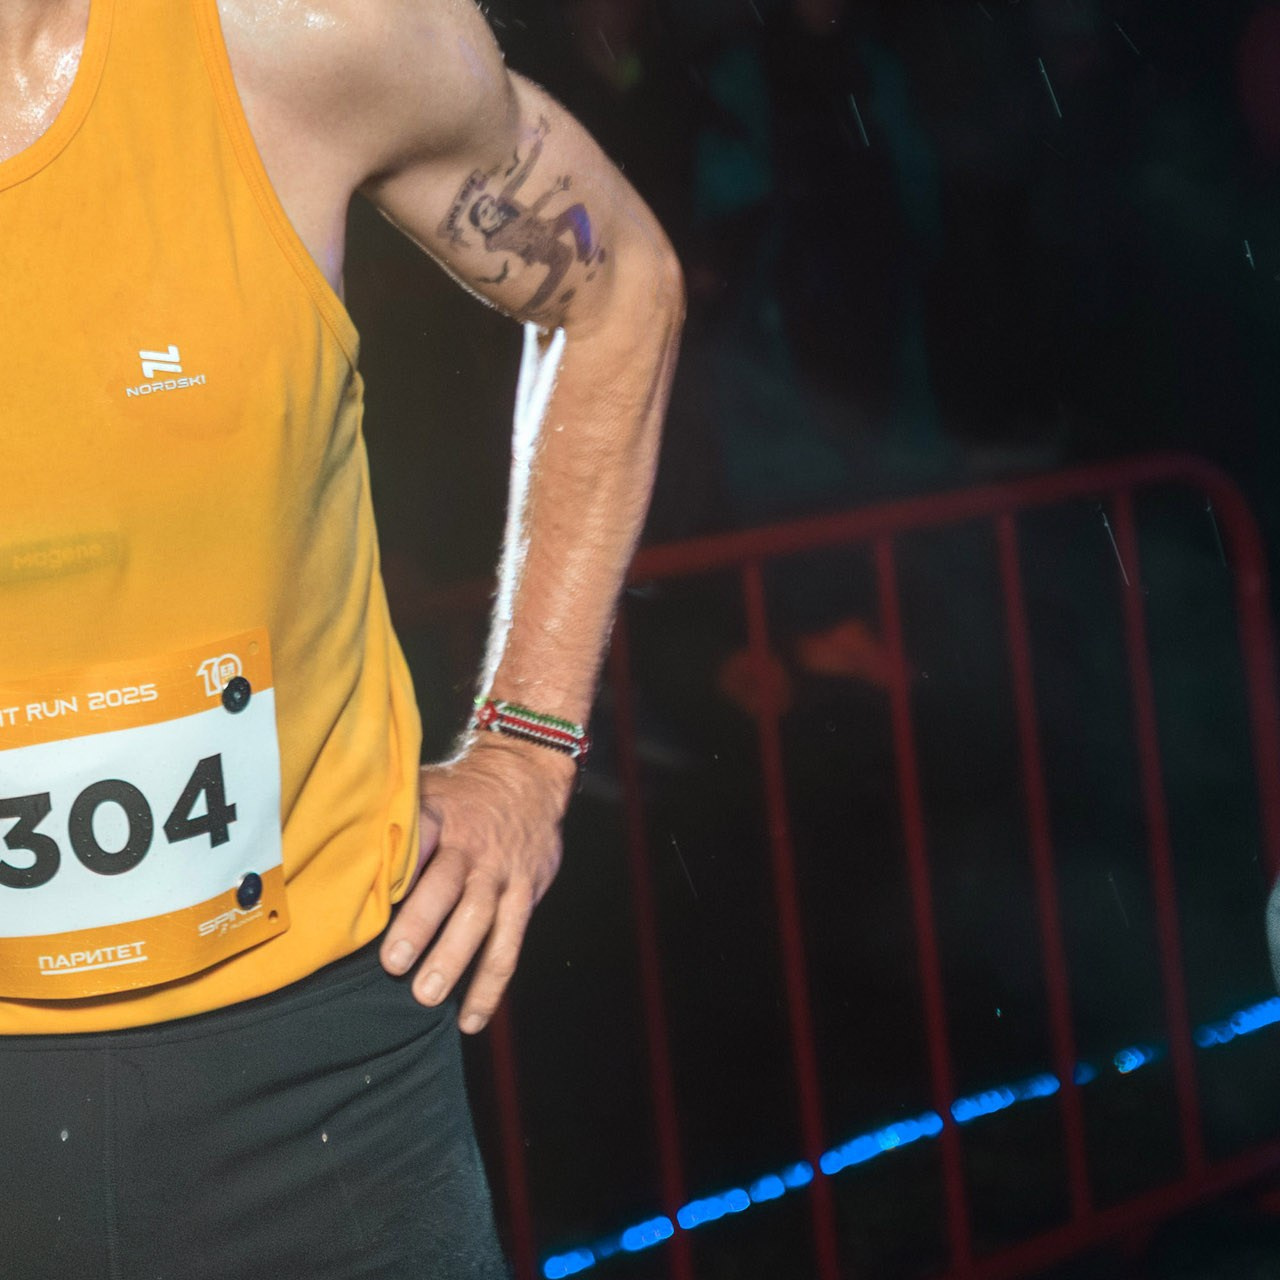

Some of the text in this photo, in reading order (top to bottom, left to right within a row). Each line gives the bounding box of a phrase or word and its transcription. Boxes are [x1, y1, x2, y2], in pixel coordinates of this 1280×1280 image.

[125, 374, 207, 397] NORDSKI
[25, 695, 79, 722] RUN
[86, 682, 159, 712] 2025
[37, 940, 147, 970] ПАРИТЕТ
